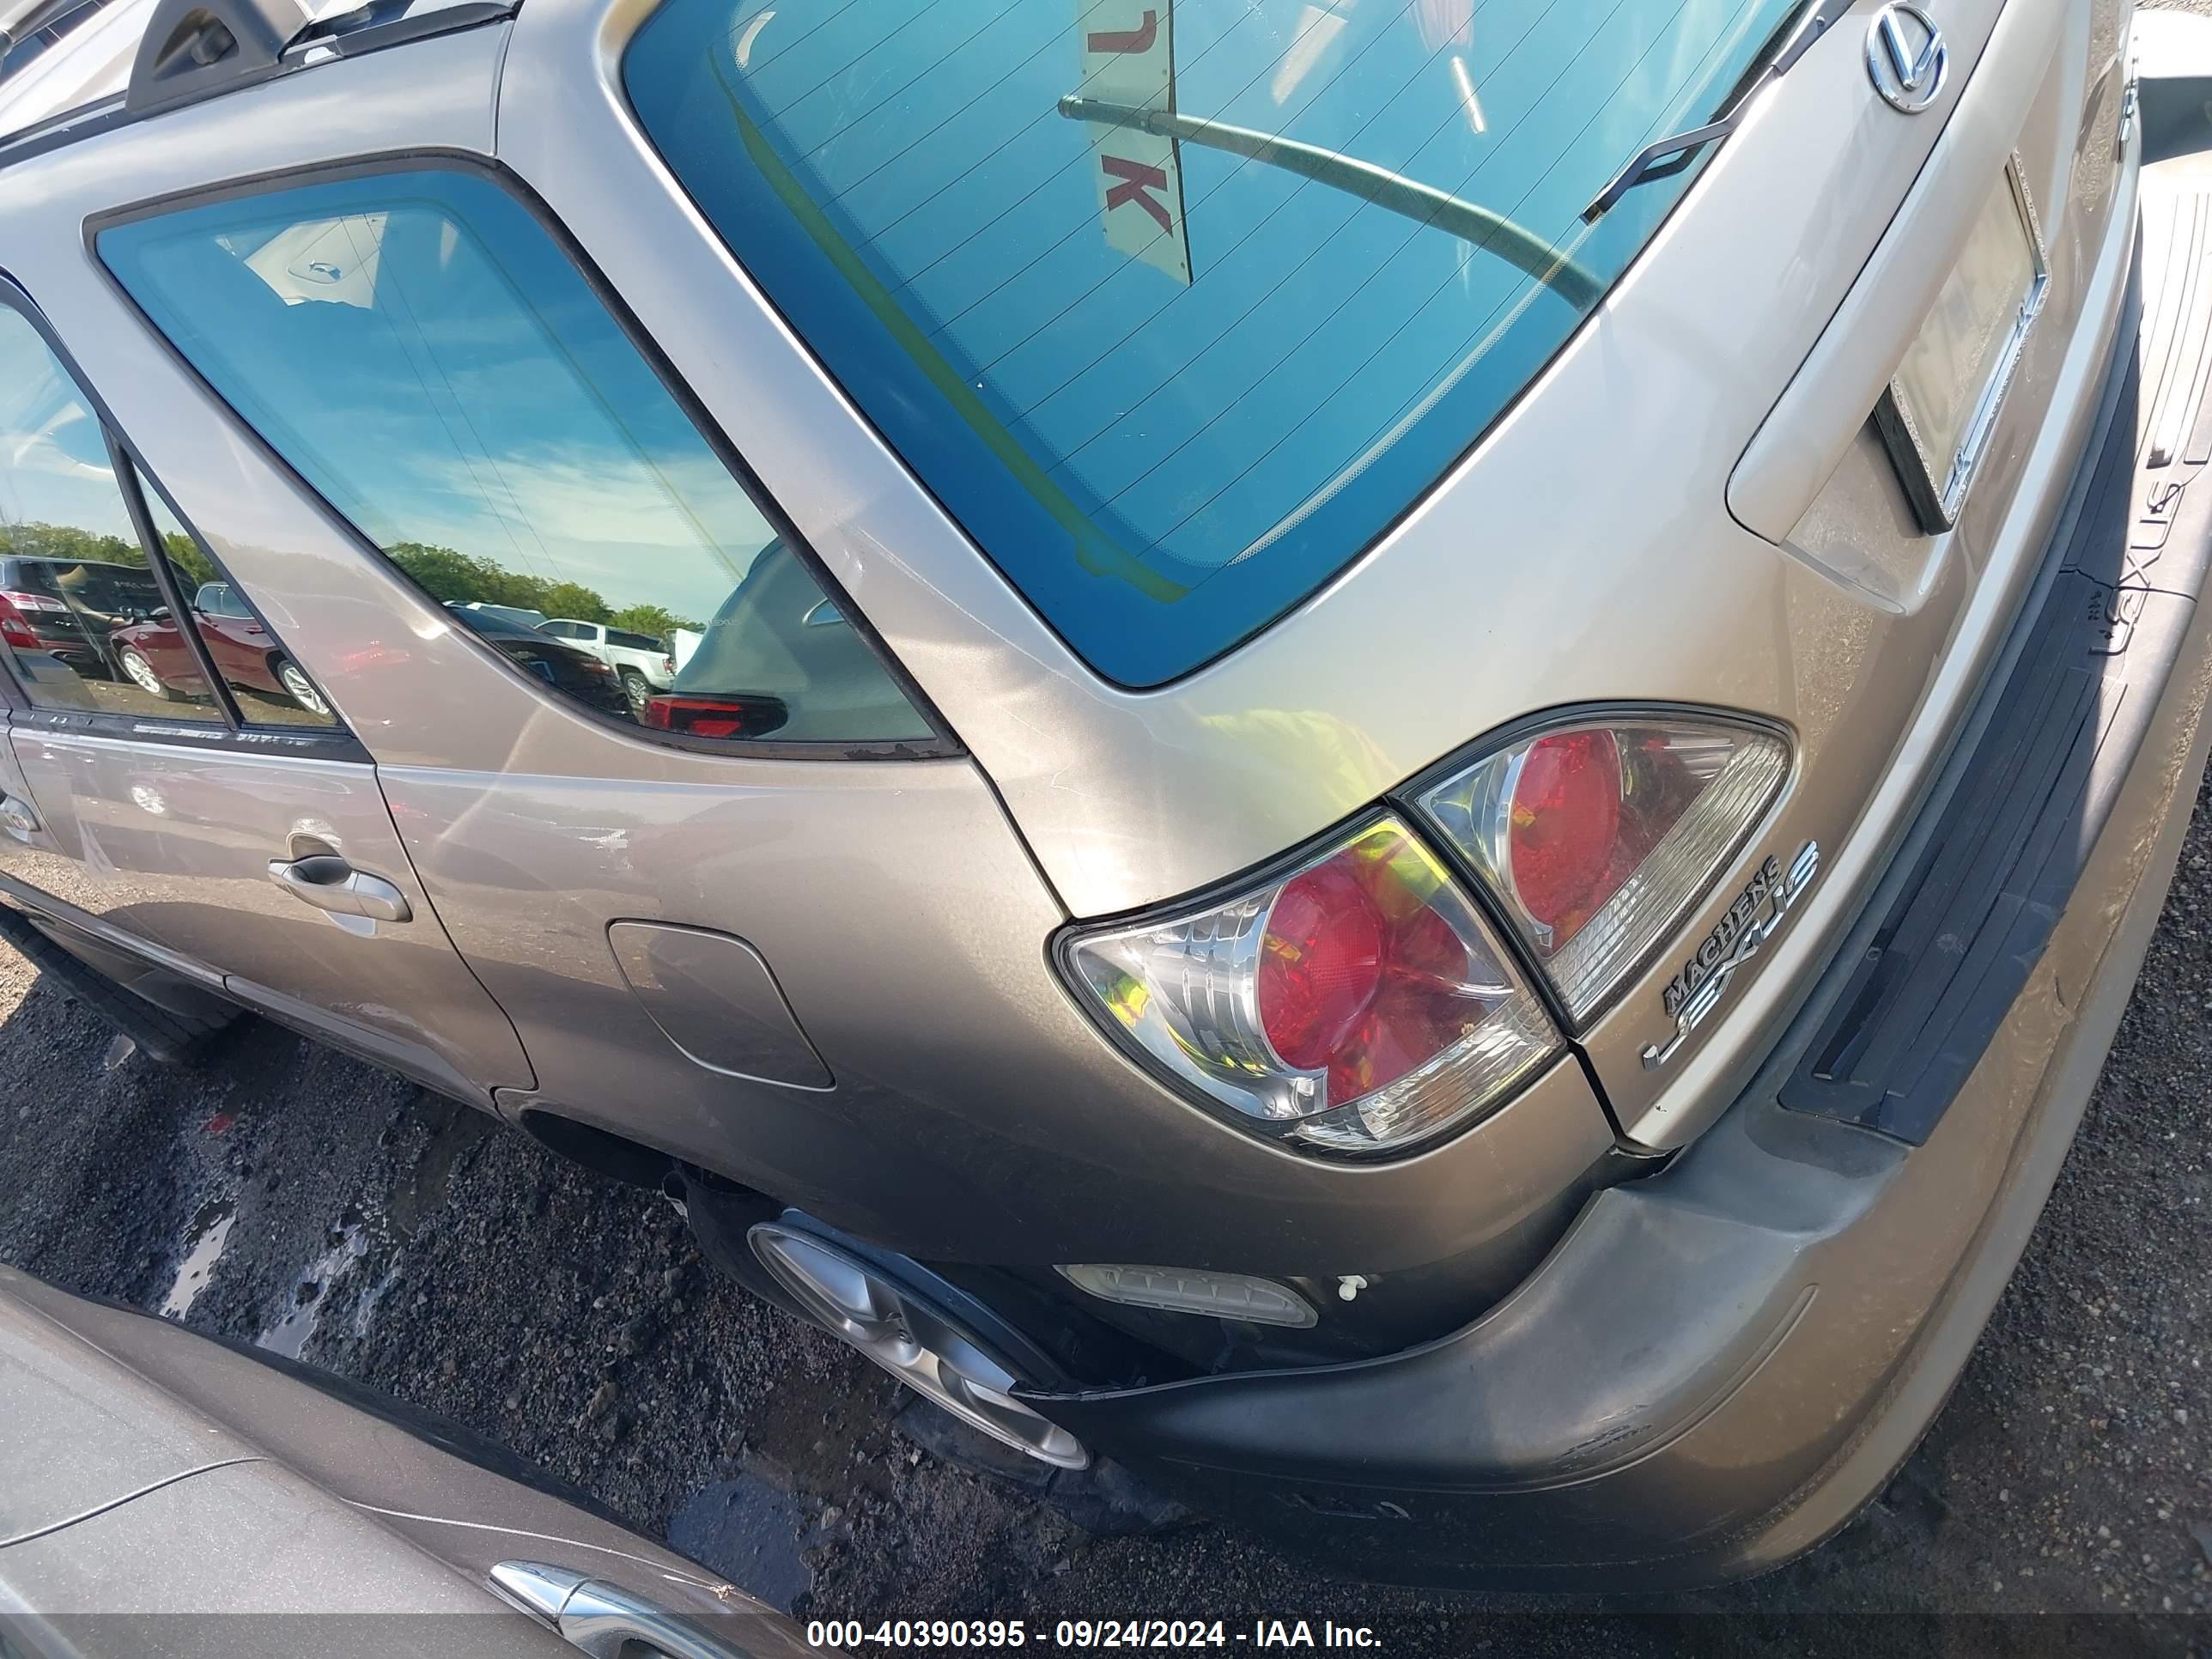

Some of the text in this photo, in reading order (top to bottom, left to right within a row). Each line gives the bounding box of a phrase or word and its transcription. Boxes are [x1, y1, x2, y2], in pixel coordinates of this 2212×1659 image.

[2087, 480, 2185, 655] LEXUS
[1642, 840, 1820, 1072] LEXUS
[1662, 854, 1783, 1018] MACHENS
